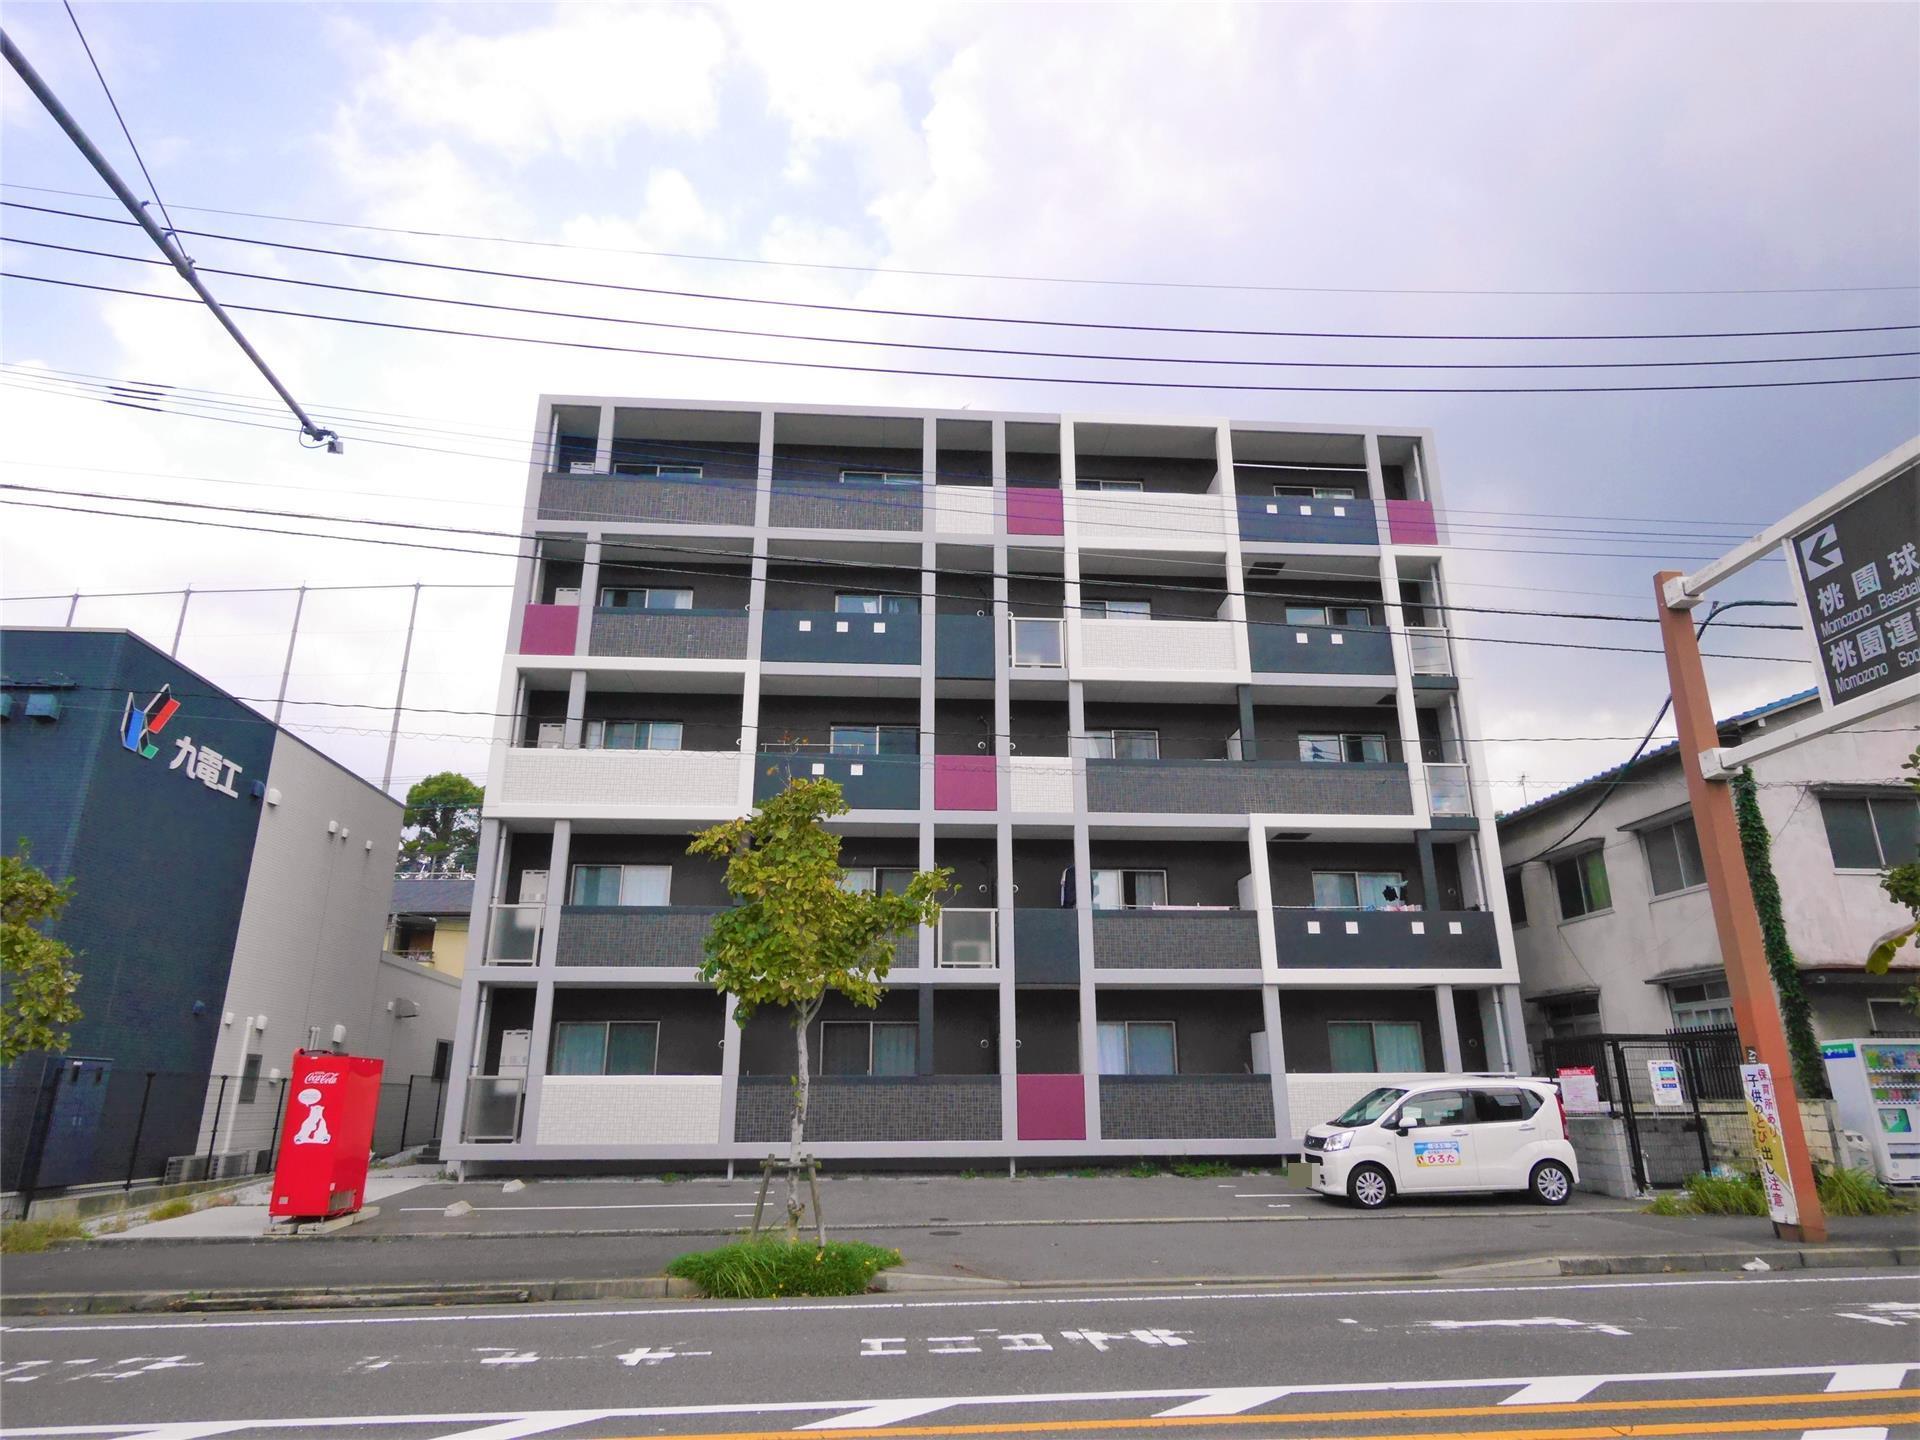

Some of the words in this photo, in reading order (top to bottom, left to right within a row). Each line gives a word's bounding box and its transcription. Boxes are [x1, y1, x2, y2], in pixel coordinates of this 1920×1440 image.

[1821, 604, 1872, 638] Momozono
[1831, 607, 1920, 673] 桃園運
[1835, 662, 1889, 694] Momozono
[169, 736, 243, 798] 九電工
[1427, 1154, 1456, 1164] ひろた
